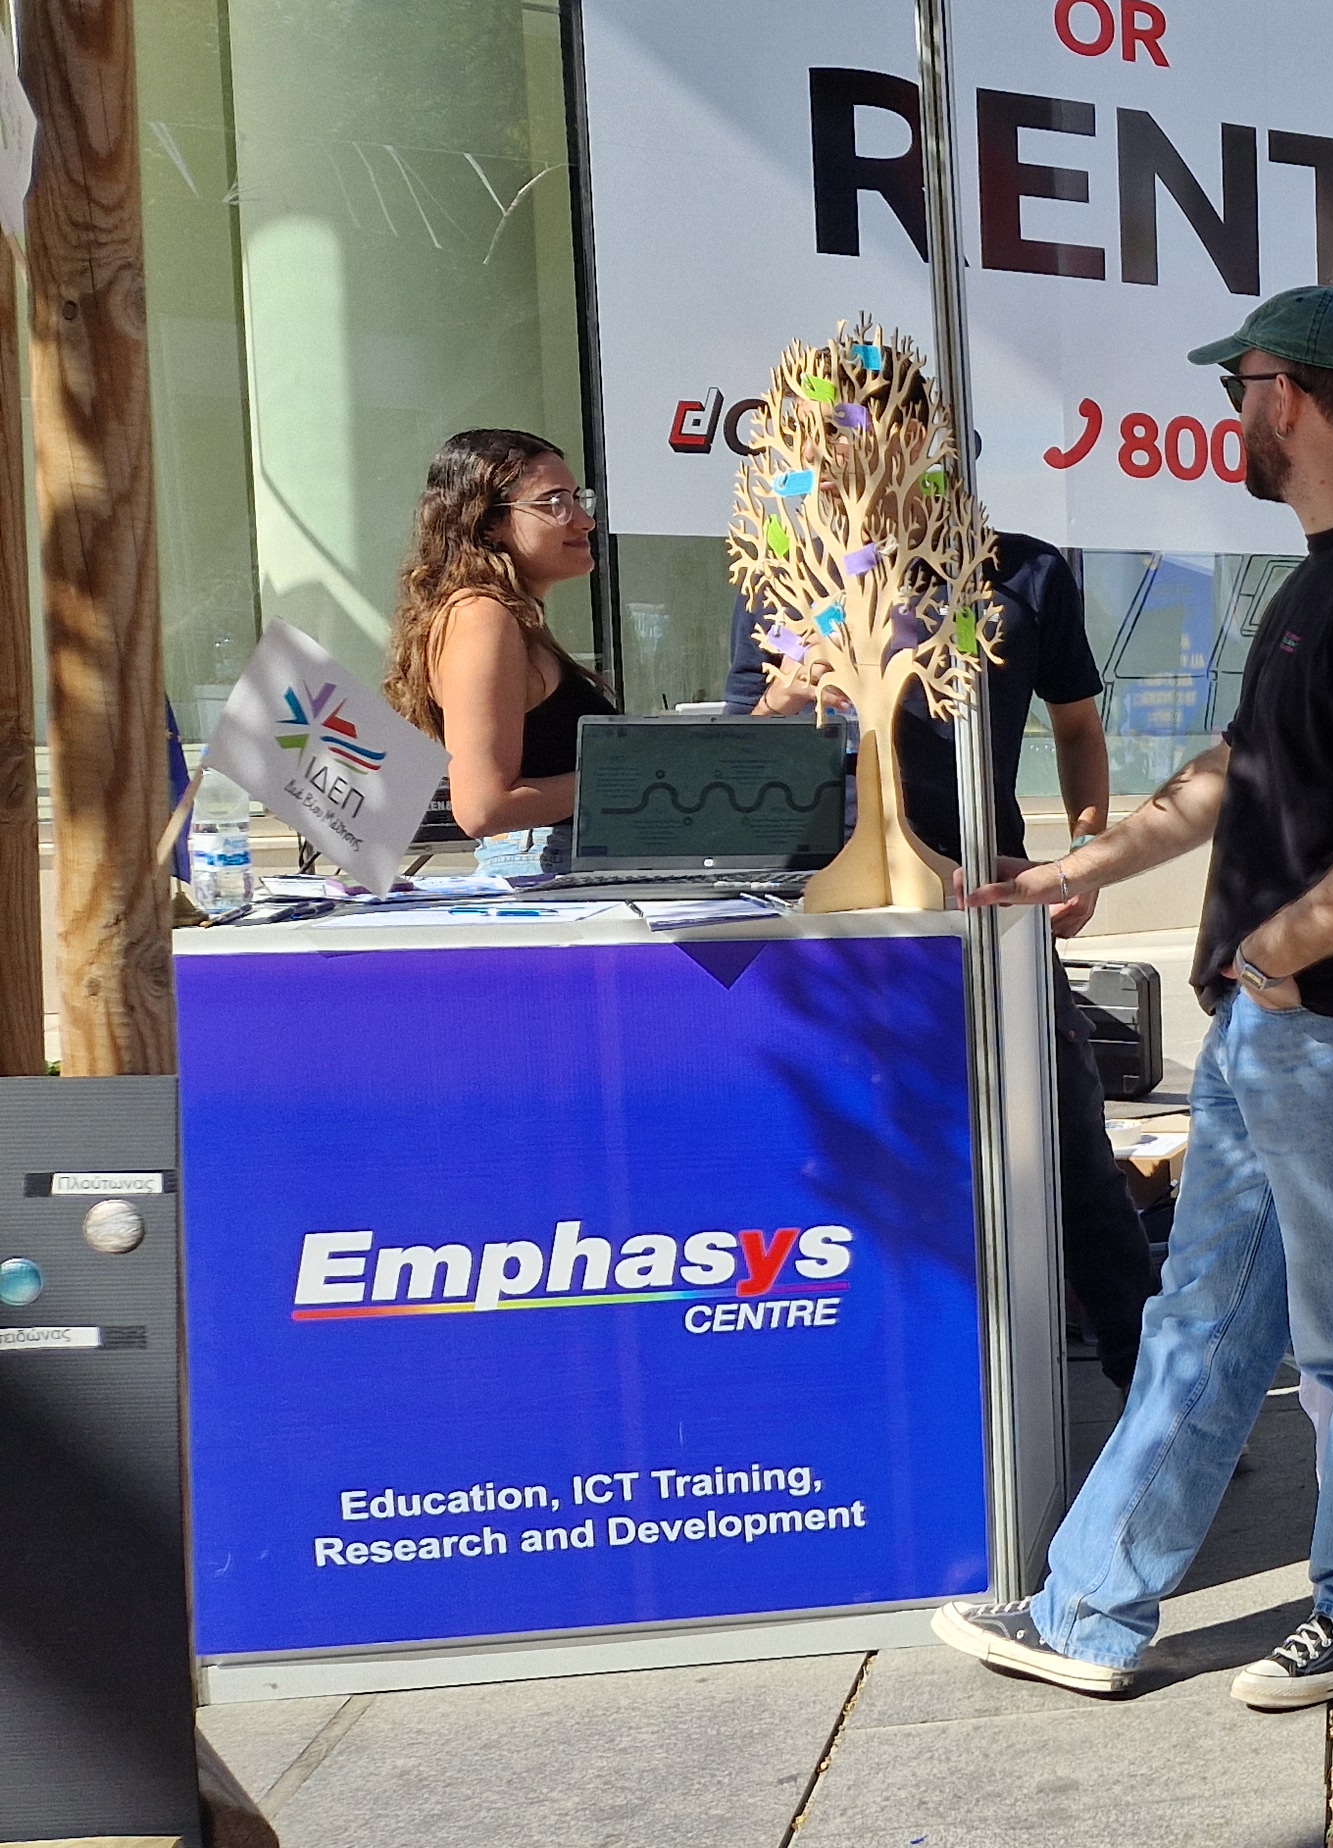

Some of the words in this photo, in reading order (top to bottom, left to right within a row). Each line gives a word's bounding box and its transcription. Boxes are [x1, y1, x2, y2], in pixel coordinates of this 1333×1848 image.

[1053, 0, 1170, 68] OR
[57, 1176, 156, 1193] Πλούτωνας
[294, 1220, 854, 1312] Emphasys
[685, 1297, 841, 1334] CENTRE
[341, 1482, 559, 1520] Education,
[572, 1472, 640, 1505] ICT
[650, 1464, 823, 1500] Training,
[315, 1526, 507, 1567] Research
[521, 1518, 595, 1553] and
[608, 1499, 867, 1546] Development
